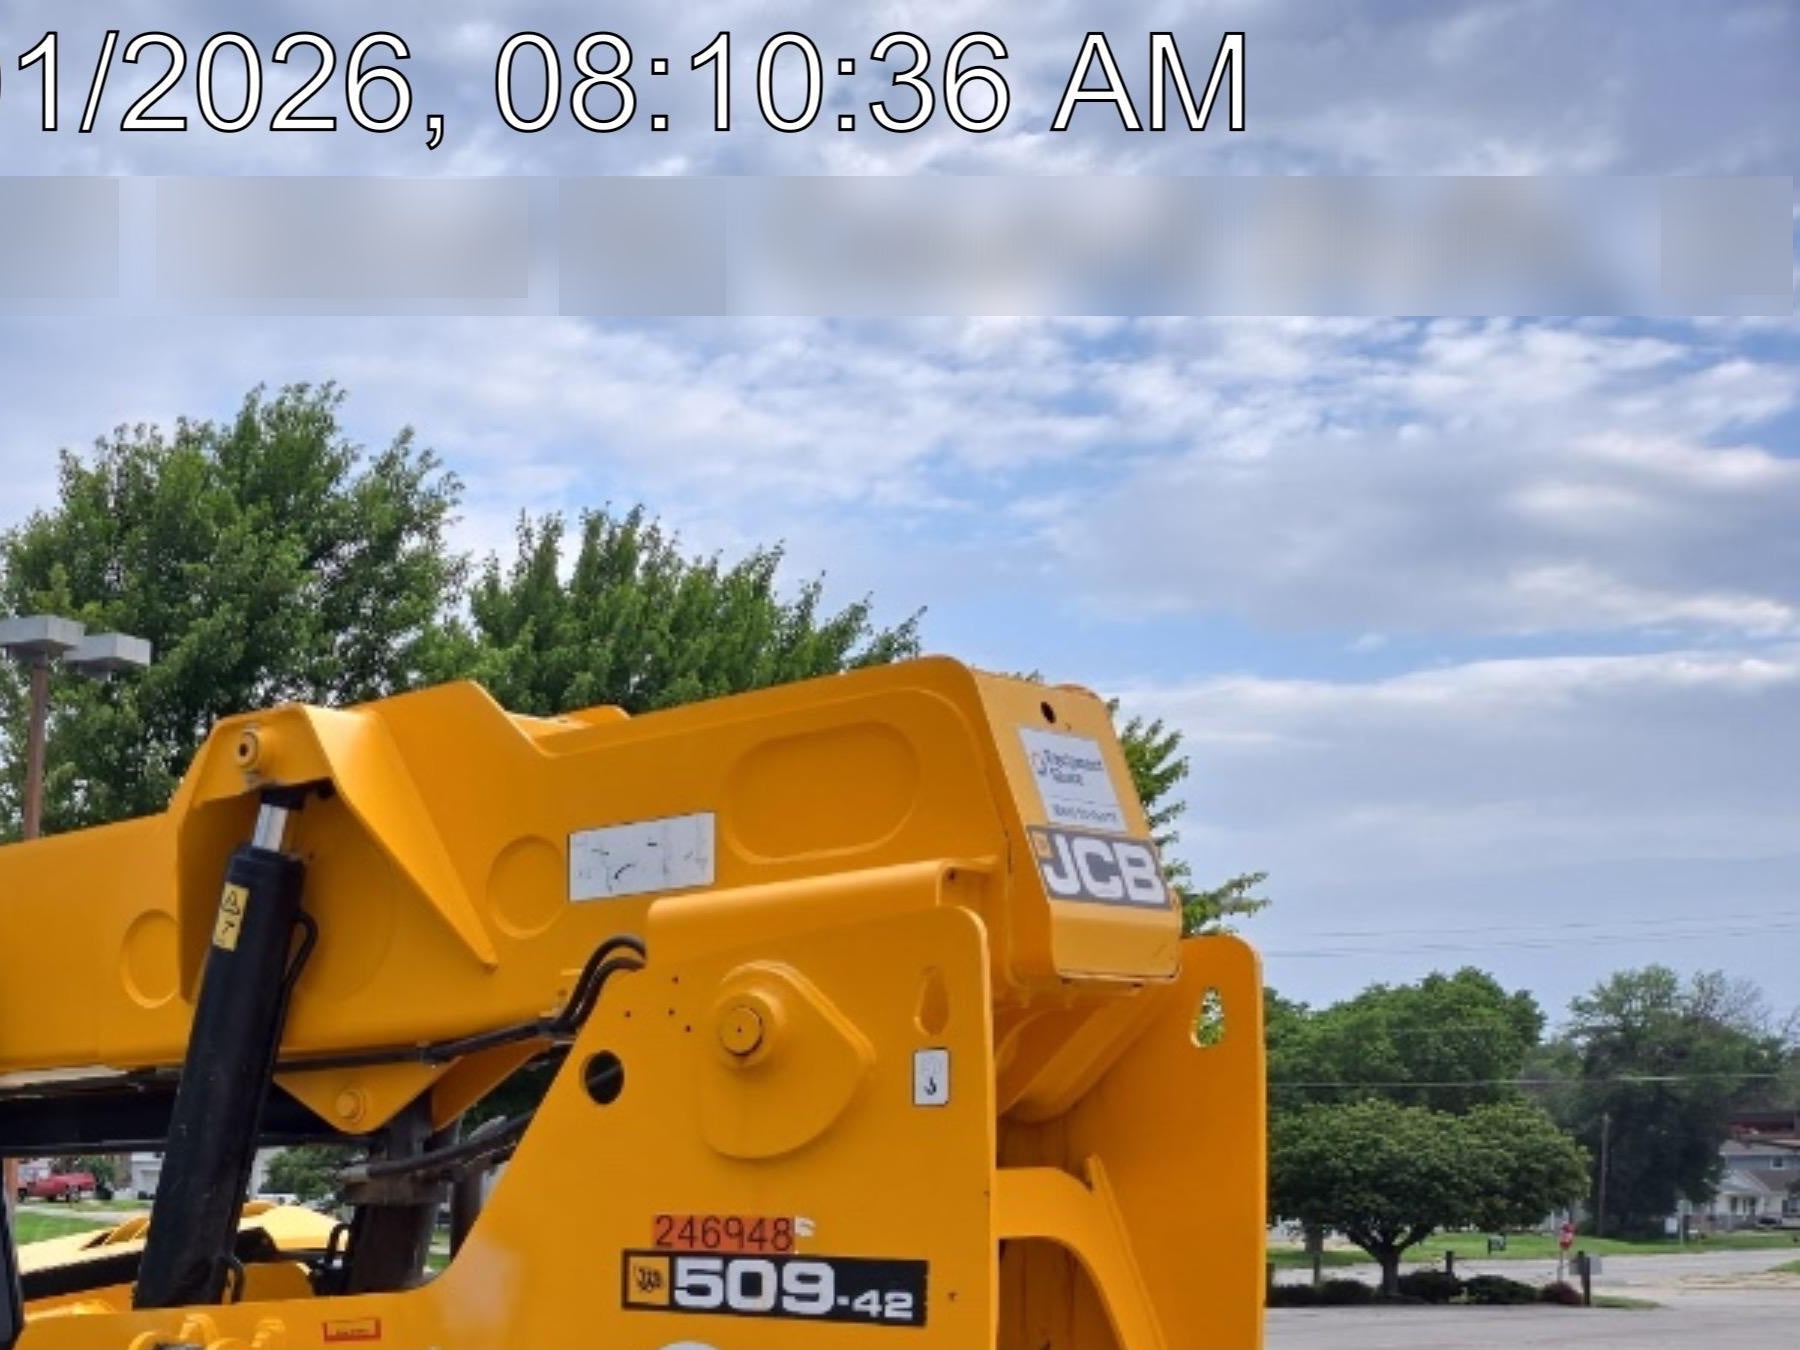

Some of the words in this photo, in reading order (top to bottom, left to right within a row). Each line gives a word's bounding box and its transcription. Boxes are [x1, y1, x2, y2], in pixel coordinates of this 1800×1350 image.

[1042, 833, 1166, 904] JCB
[654, 1214, 794, 1252] 246948
[673, 1256, 914, 1319] 509-42
